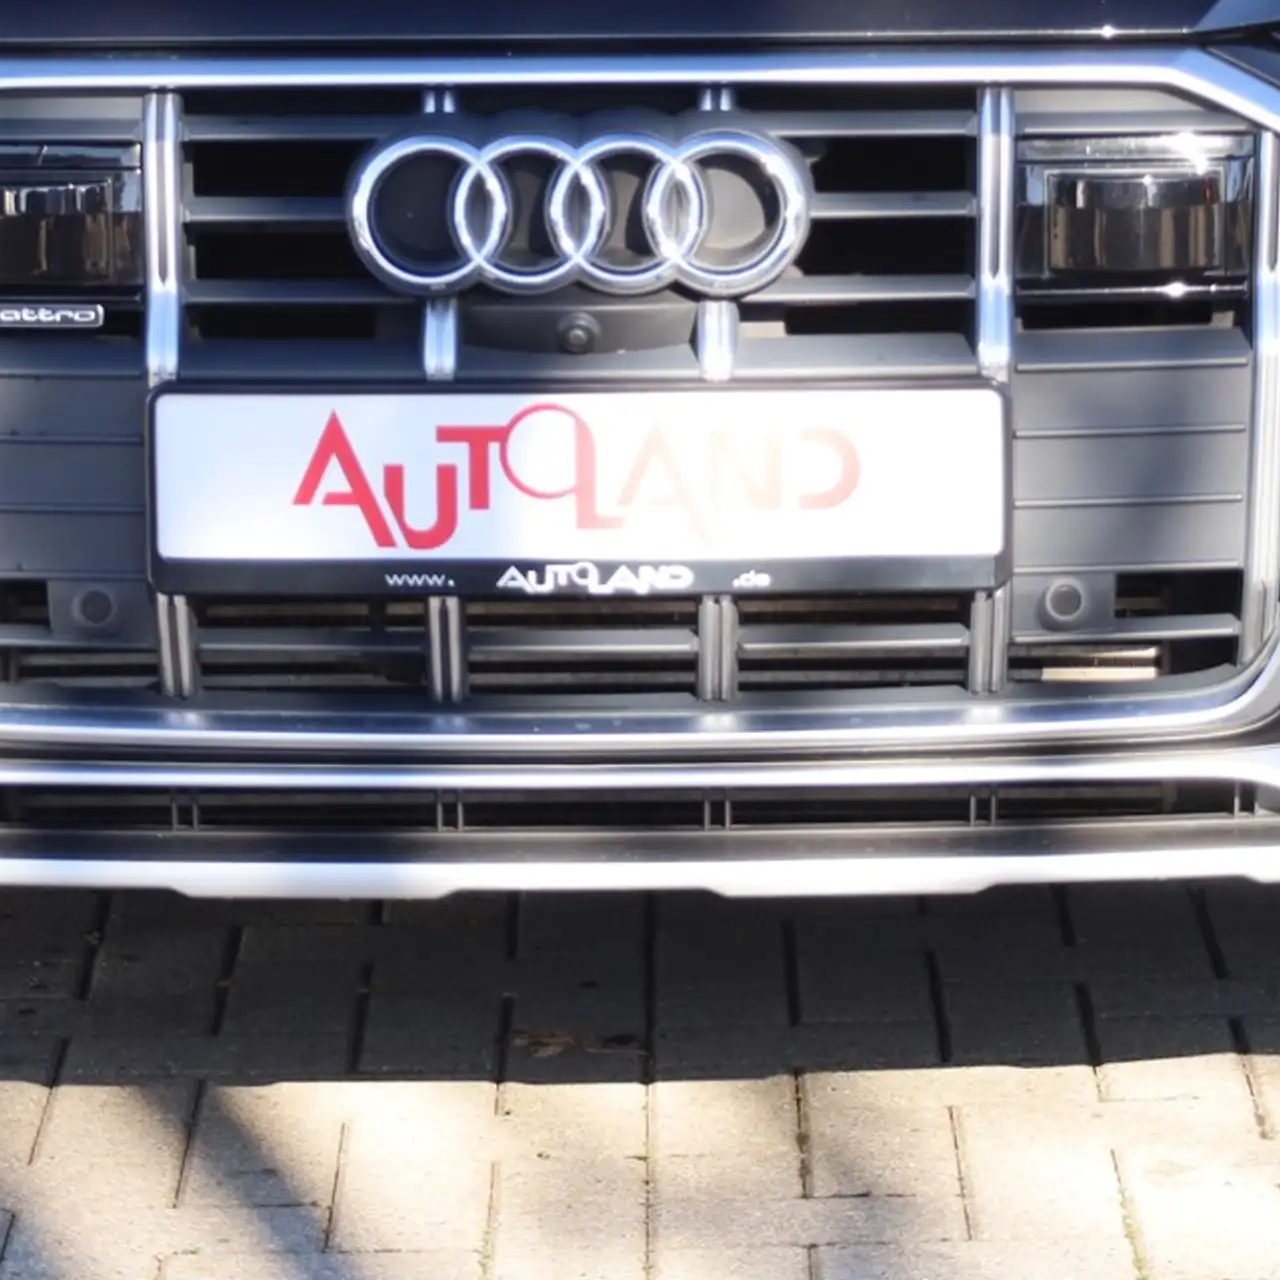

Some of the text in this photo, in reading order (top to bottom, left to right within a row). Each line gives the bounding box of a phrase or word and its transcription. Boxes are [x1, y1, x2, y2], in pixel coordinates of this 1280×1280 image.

[292, 402, 862, 551] AUTOLAND
[384, 571, 455, 588] www.
[495, 561, 695, 595] AUTOLAND
